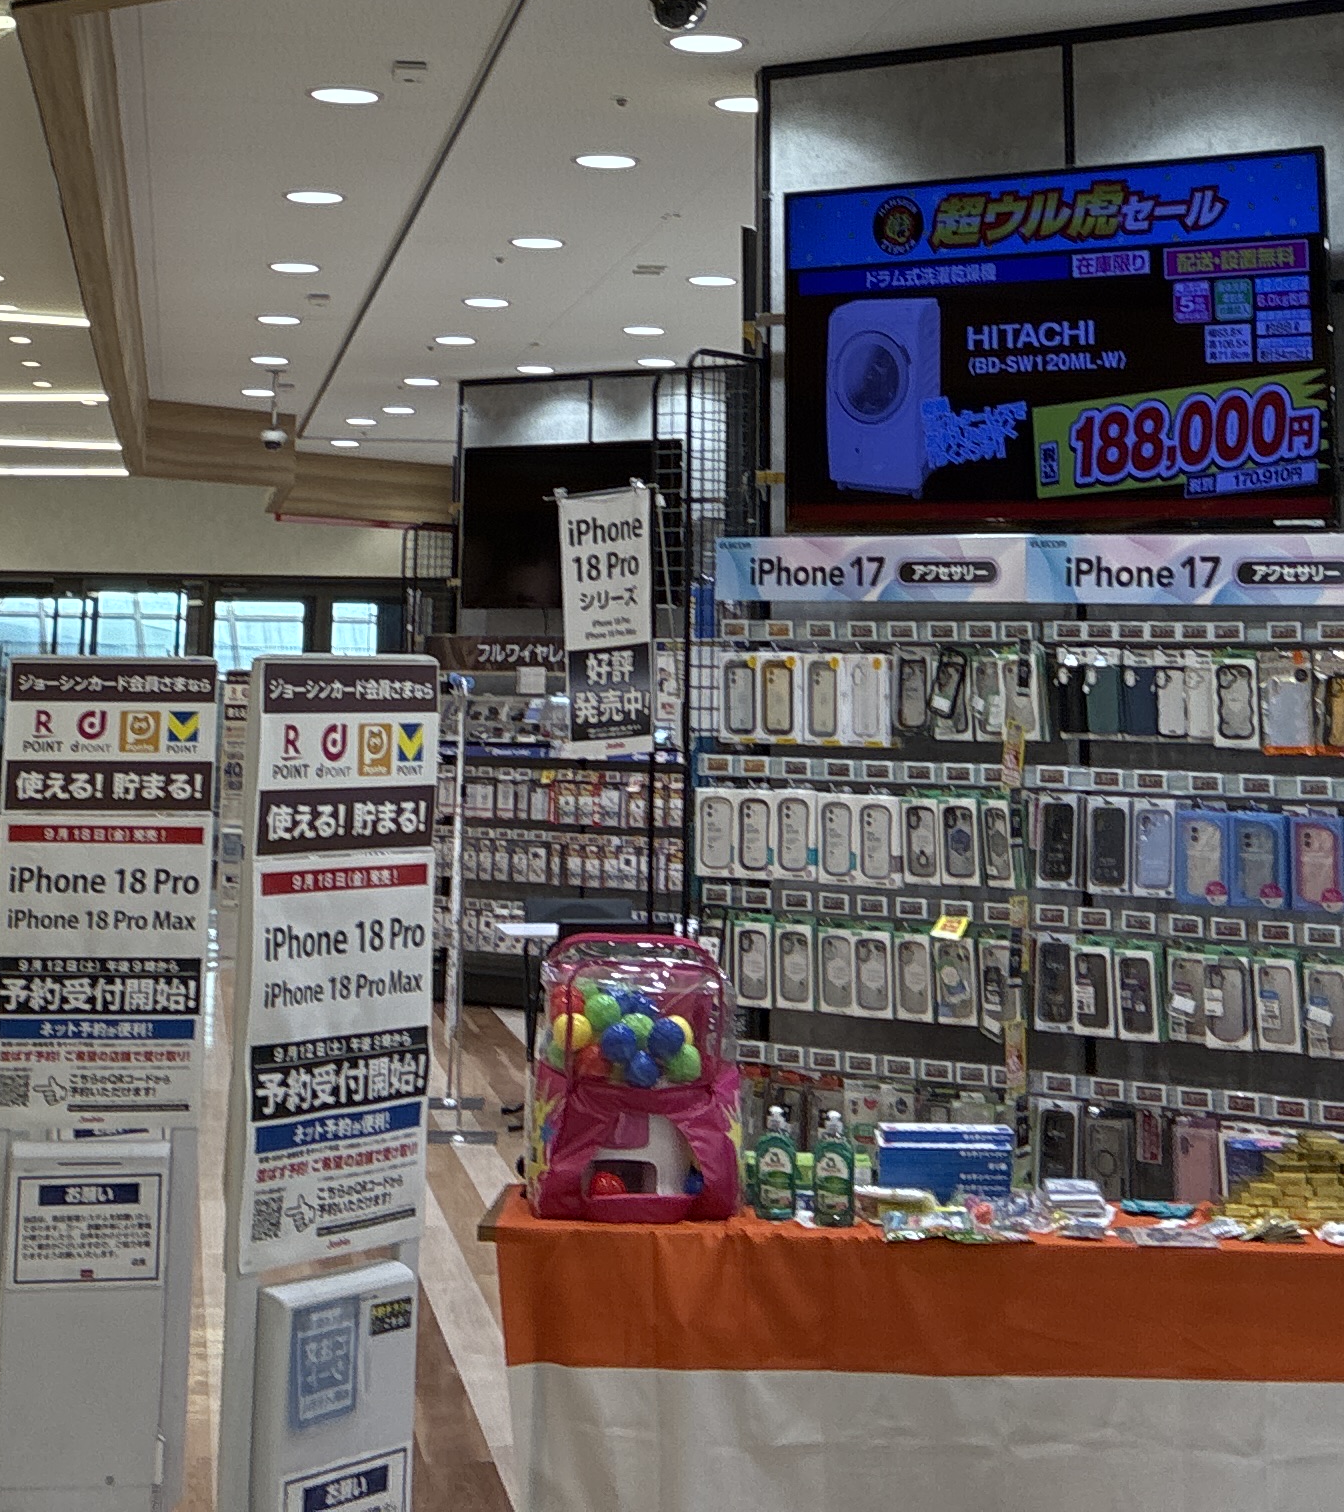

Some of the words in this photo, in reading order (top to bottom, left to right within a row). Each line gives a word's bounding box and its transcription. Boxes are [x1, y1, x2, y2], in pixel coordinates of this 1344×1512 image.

[932, 181, 1224, 251] 超ウル虎セール
[1075, 253, 1147, 276] 在庫限り
[967, 320, 1095, 352] HITACHI
[1076, 389, 1314, 478] 188,000円
[568, 517, 643, 546] iPhone
[573, 554, 601, 583] 18
[607, 552, 639, 579] Pro
[750, 557, 845, 587] iPhone
[851, 556, 885, 587] 17
[911, 564, 989, 581] アクセサリー
[1066, 556, 1174, 588] iPhone
[1181, 556, 1220, 588] 17
[1251, 564, 1340, 582] アクセサリー
[580, 585, 638, 612] シリーズ
[477, 643, 565, 663] フルワイヤレ
[586, 650, 634, 686] 好評
[18, 674, 211, 693] ジョーシンカード会員さまなら
[269, 678, 434, 701] ジョーシンカード会員さまなら
[23, 741, 64, 753] POINT
[16, 771, 104, 801] 使える!
[112, 772, 204, 800] 貯まる!
[272, 764, 310, 779] POINT
[266, 804, 347, 841] 使える!
[352, 800, 427, 838] 貯まる!
[9, 867, 105, 896] iPhone
[113, 868, 146, 894] 18
[155, 868, 199, 895] Pro
[7, 910, 79, 931] iPhone
[85, 910, 109, 930] 18
[114, 910, 147, 931] Pro
[153, 911, 196, 931] Max
[263, 927, 347, 962] iPhone
[355, 922, 385, 950] 18
[389, 919, 426, 949] Pro
[263, 980, 323, 1009] iPhone
[328, 977, 351, 1001] 18
[356, 975, 385, 999] Pro
[388, 970, 423, 995] Max
[256, 1053, 426, 1116] 予約受付開始!
